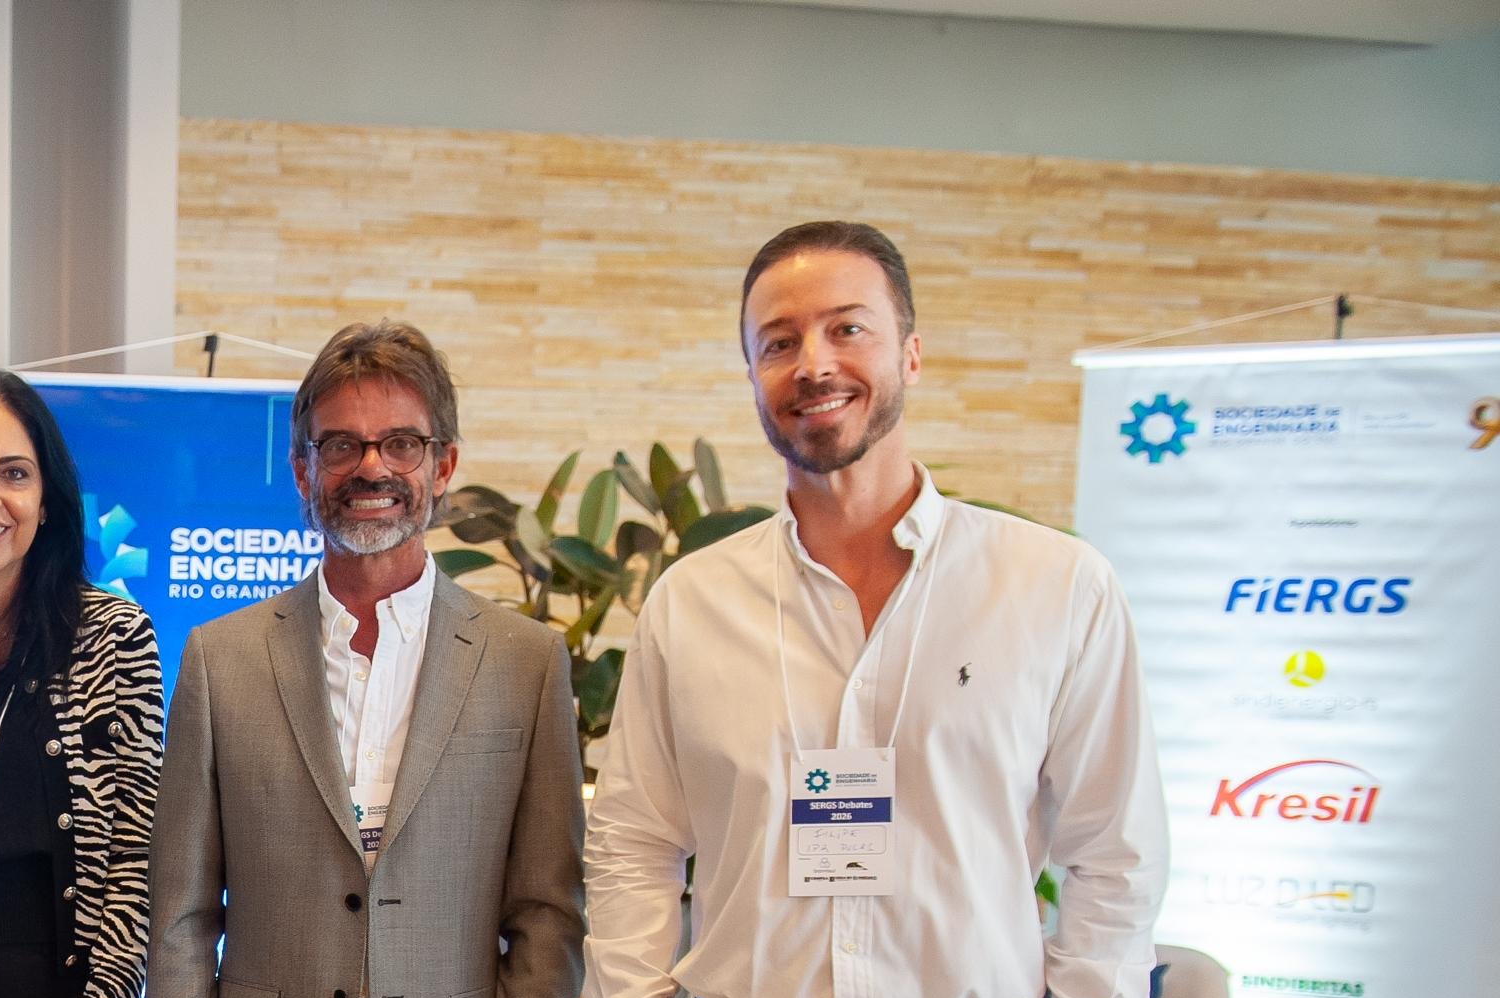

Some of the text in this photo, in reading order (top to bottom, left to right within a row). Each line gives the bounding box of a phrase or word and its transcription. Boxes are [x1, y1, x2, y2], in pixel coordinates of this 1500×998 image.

[170, 527, 325, 554] SOCIEDAD
[168, 583, 204, 598] RIO
[810, 801, 874, 810] SERGS Debates
[1208, 779, 1381, 824] Kresil
[831, 812, 853, 820] 2026
